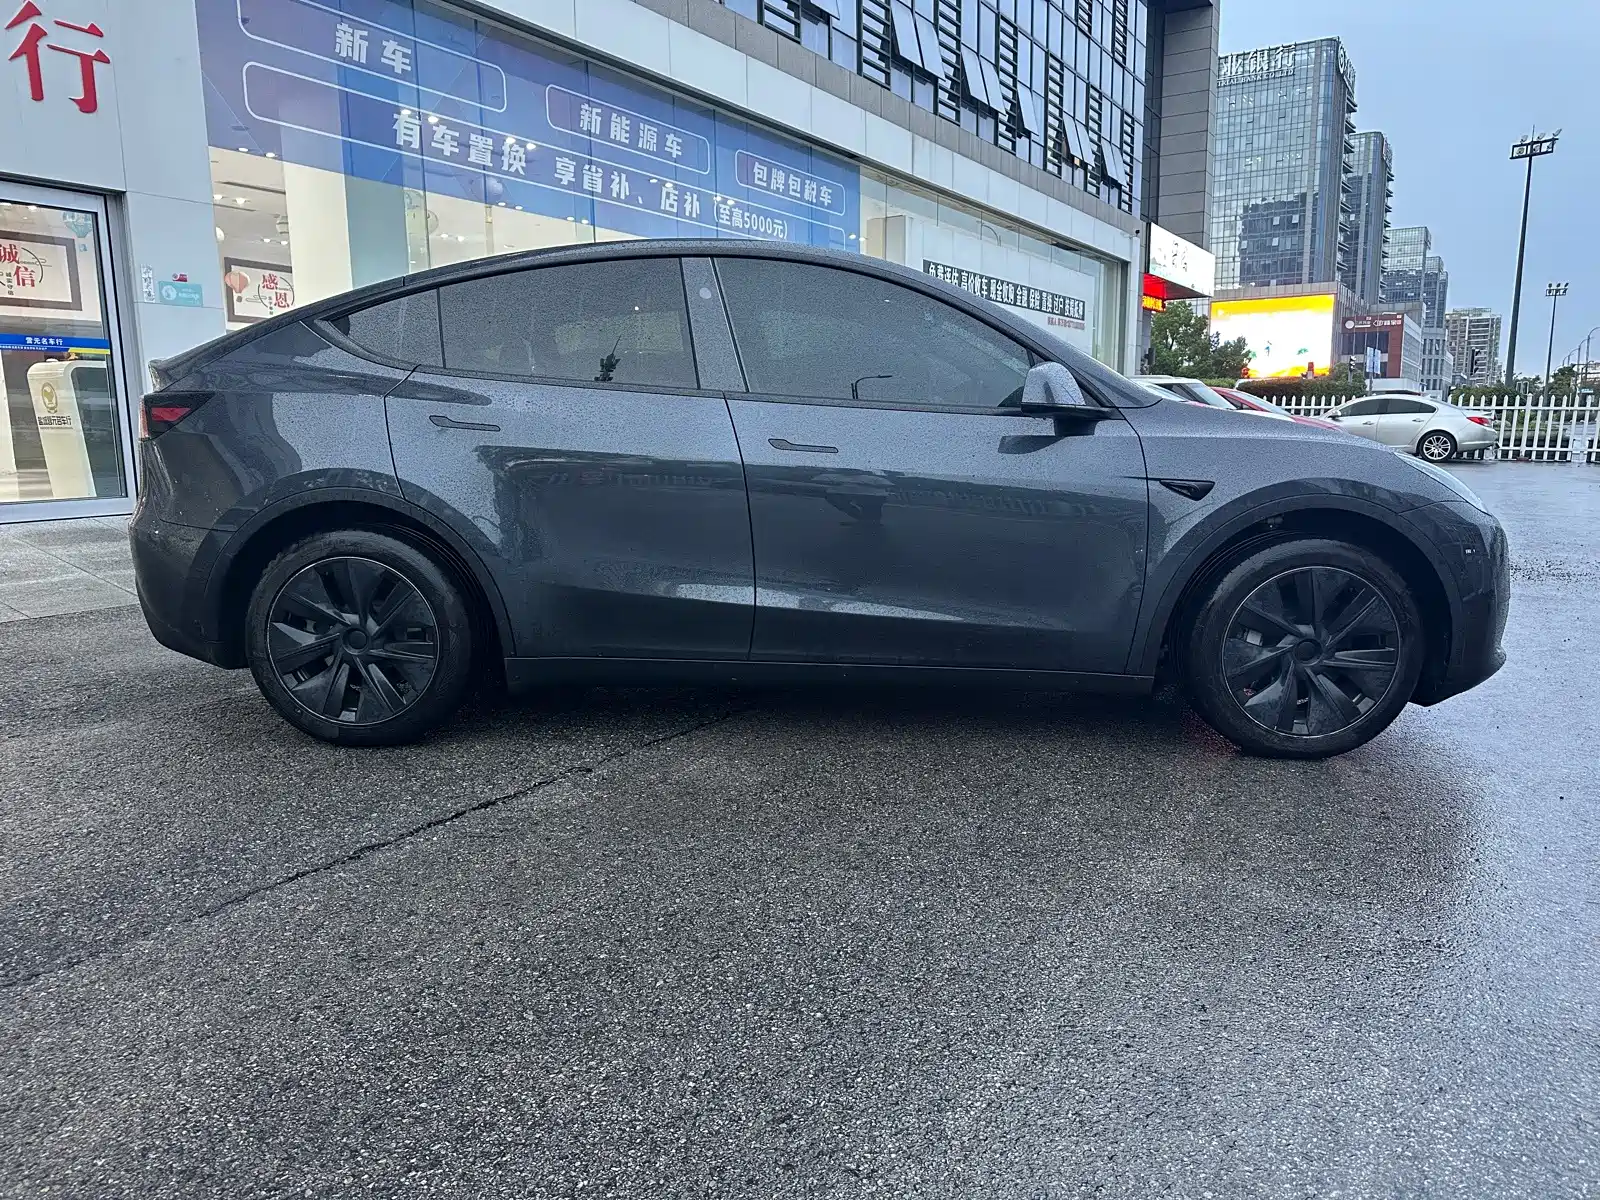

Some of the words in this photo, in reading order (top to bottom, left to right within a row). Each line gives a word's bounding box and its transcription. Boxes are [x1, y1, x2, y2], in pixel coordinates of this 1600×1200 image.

[5, 0, 110, 113] 行
[334, 22, 412, 74] 新车
[392, 111, 526, 176] 有车置换
[580, 102, 682, 158] 新能源车
[753, 161, 832, 206] 包牌包税车
